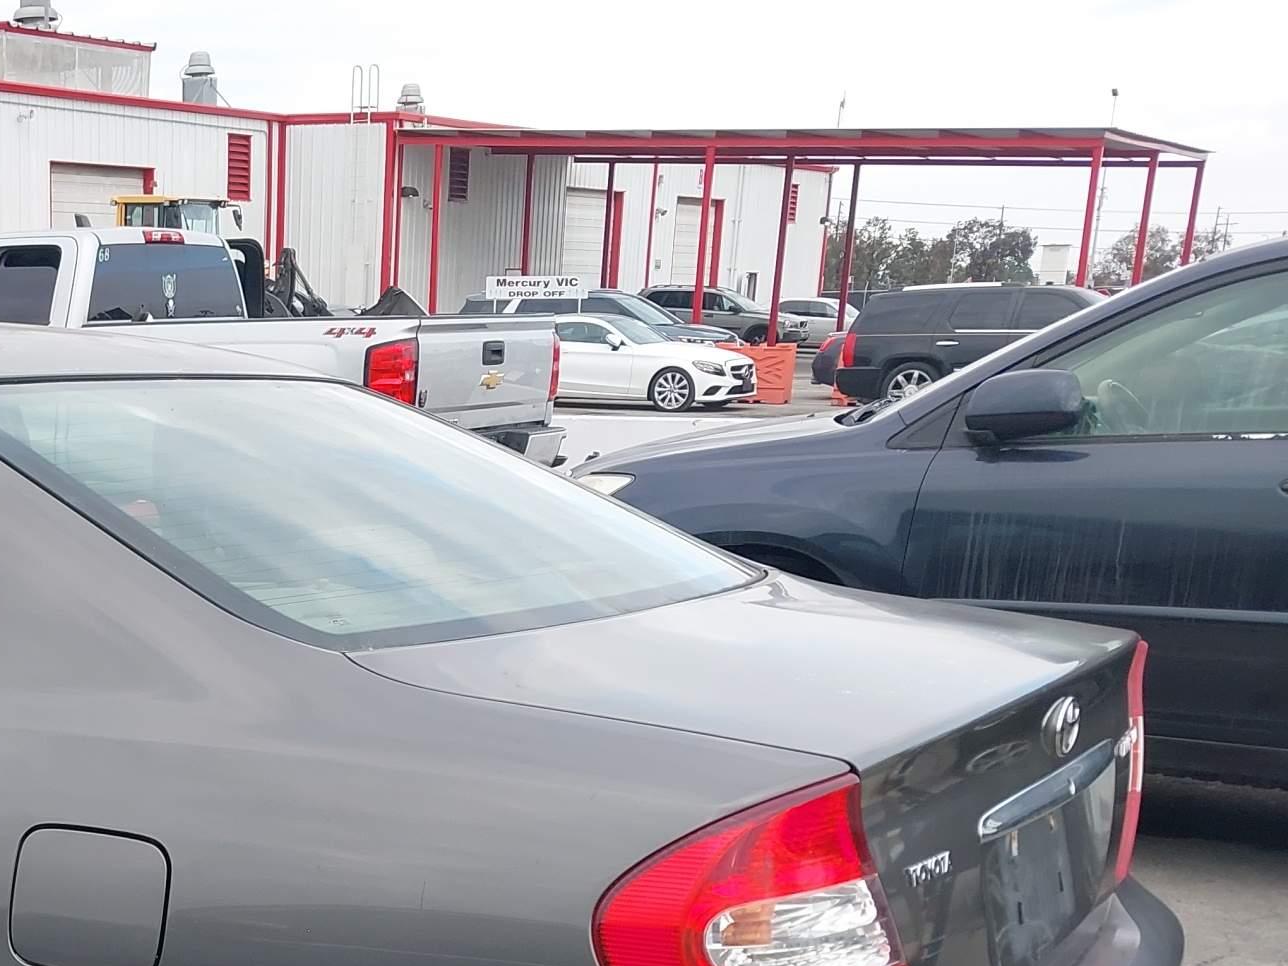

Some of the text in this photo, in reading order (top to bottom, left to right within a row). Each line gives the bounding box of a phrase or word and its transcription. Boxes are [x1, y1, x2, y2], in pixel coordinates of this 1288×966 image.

[496, 277, 579, 288] Mercury VIC
[508, 290, 566, 298] DROP OFF
